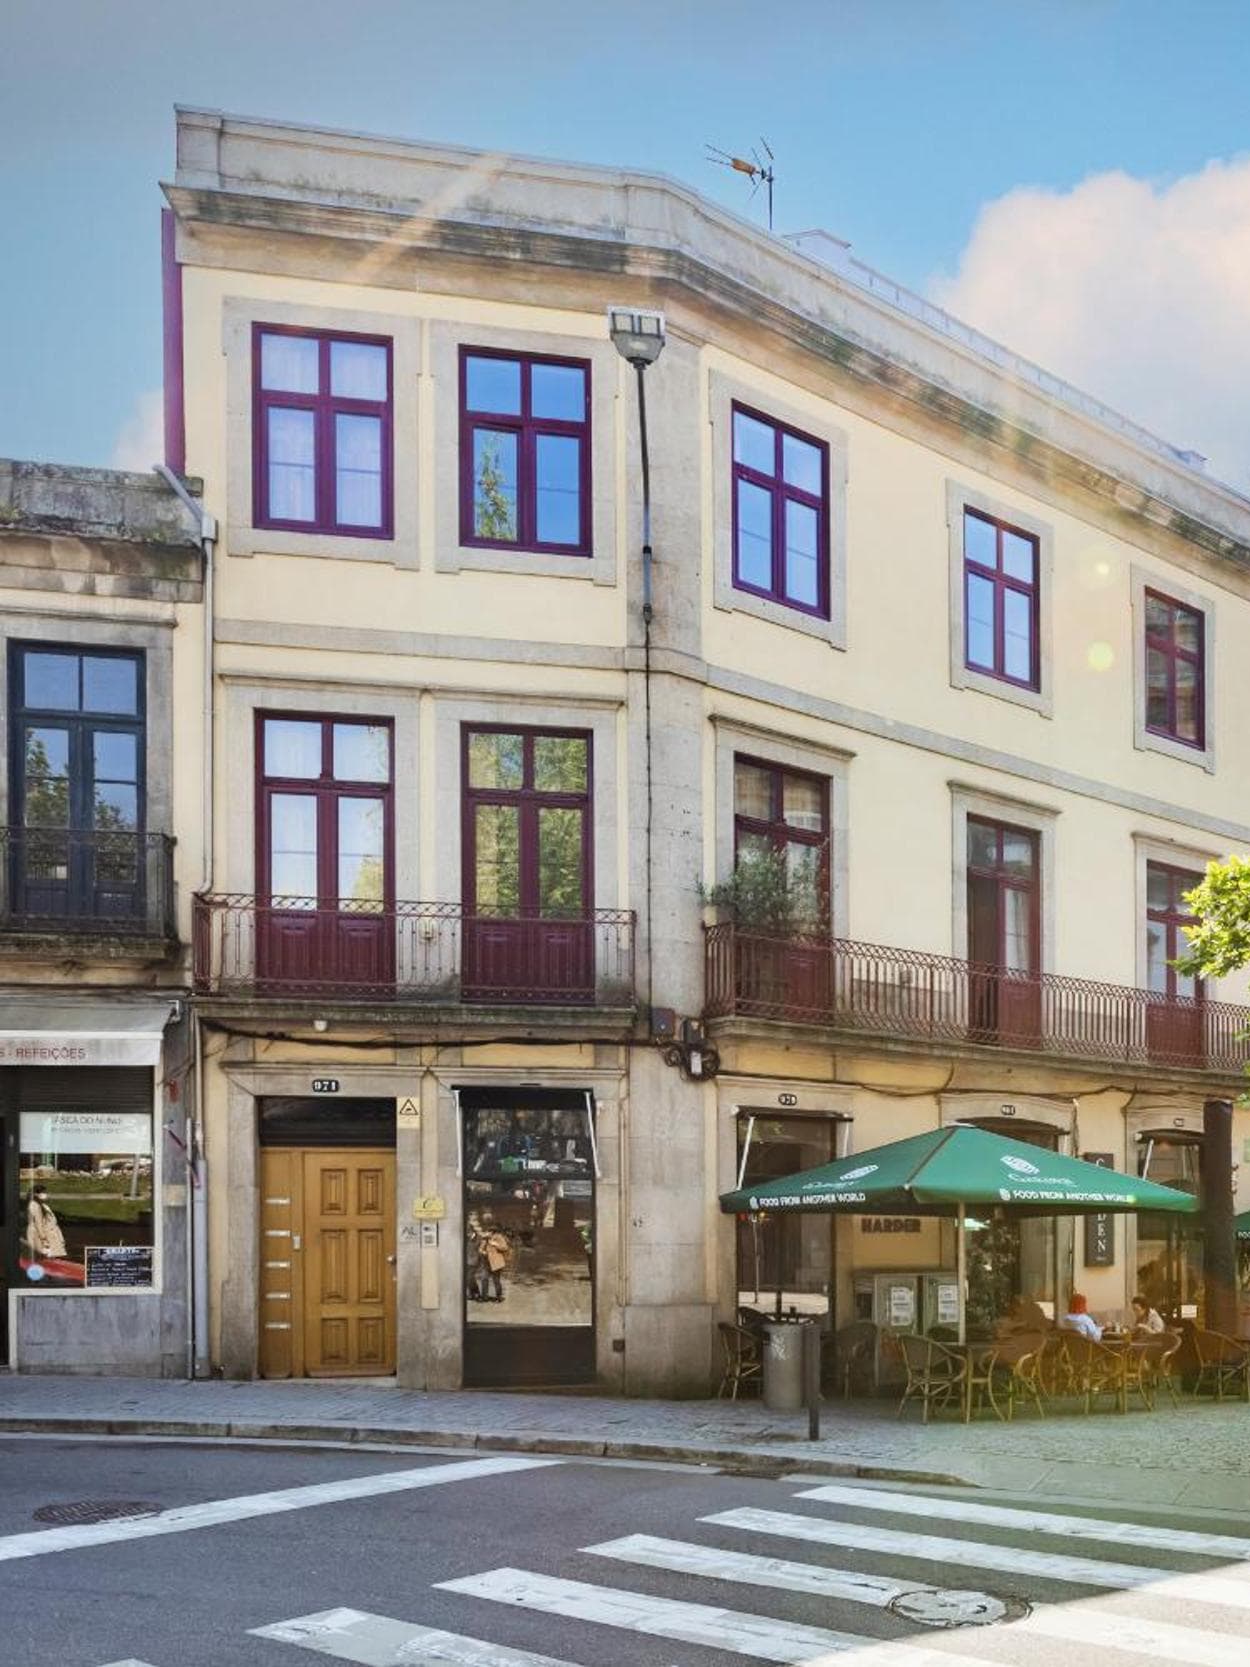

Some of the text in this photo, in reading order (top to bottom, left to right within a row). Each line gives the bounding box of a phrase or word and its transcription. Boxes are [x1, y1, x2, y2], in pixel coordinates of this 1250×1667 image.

[16, 1046, 86, 1060] REFEIÇÕES
[1013, 1189, 1039, 1199] FOOD
[861, 1218, 921, 1233] HARDER
